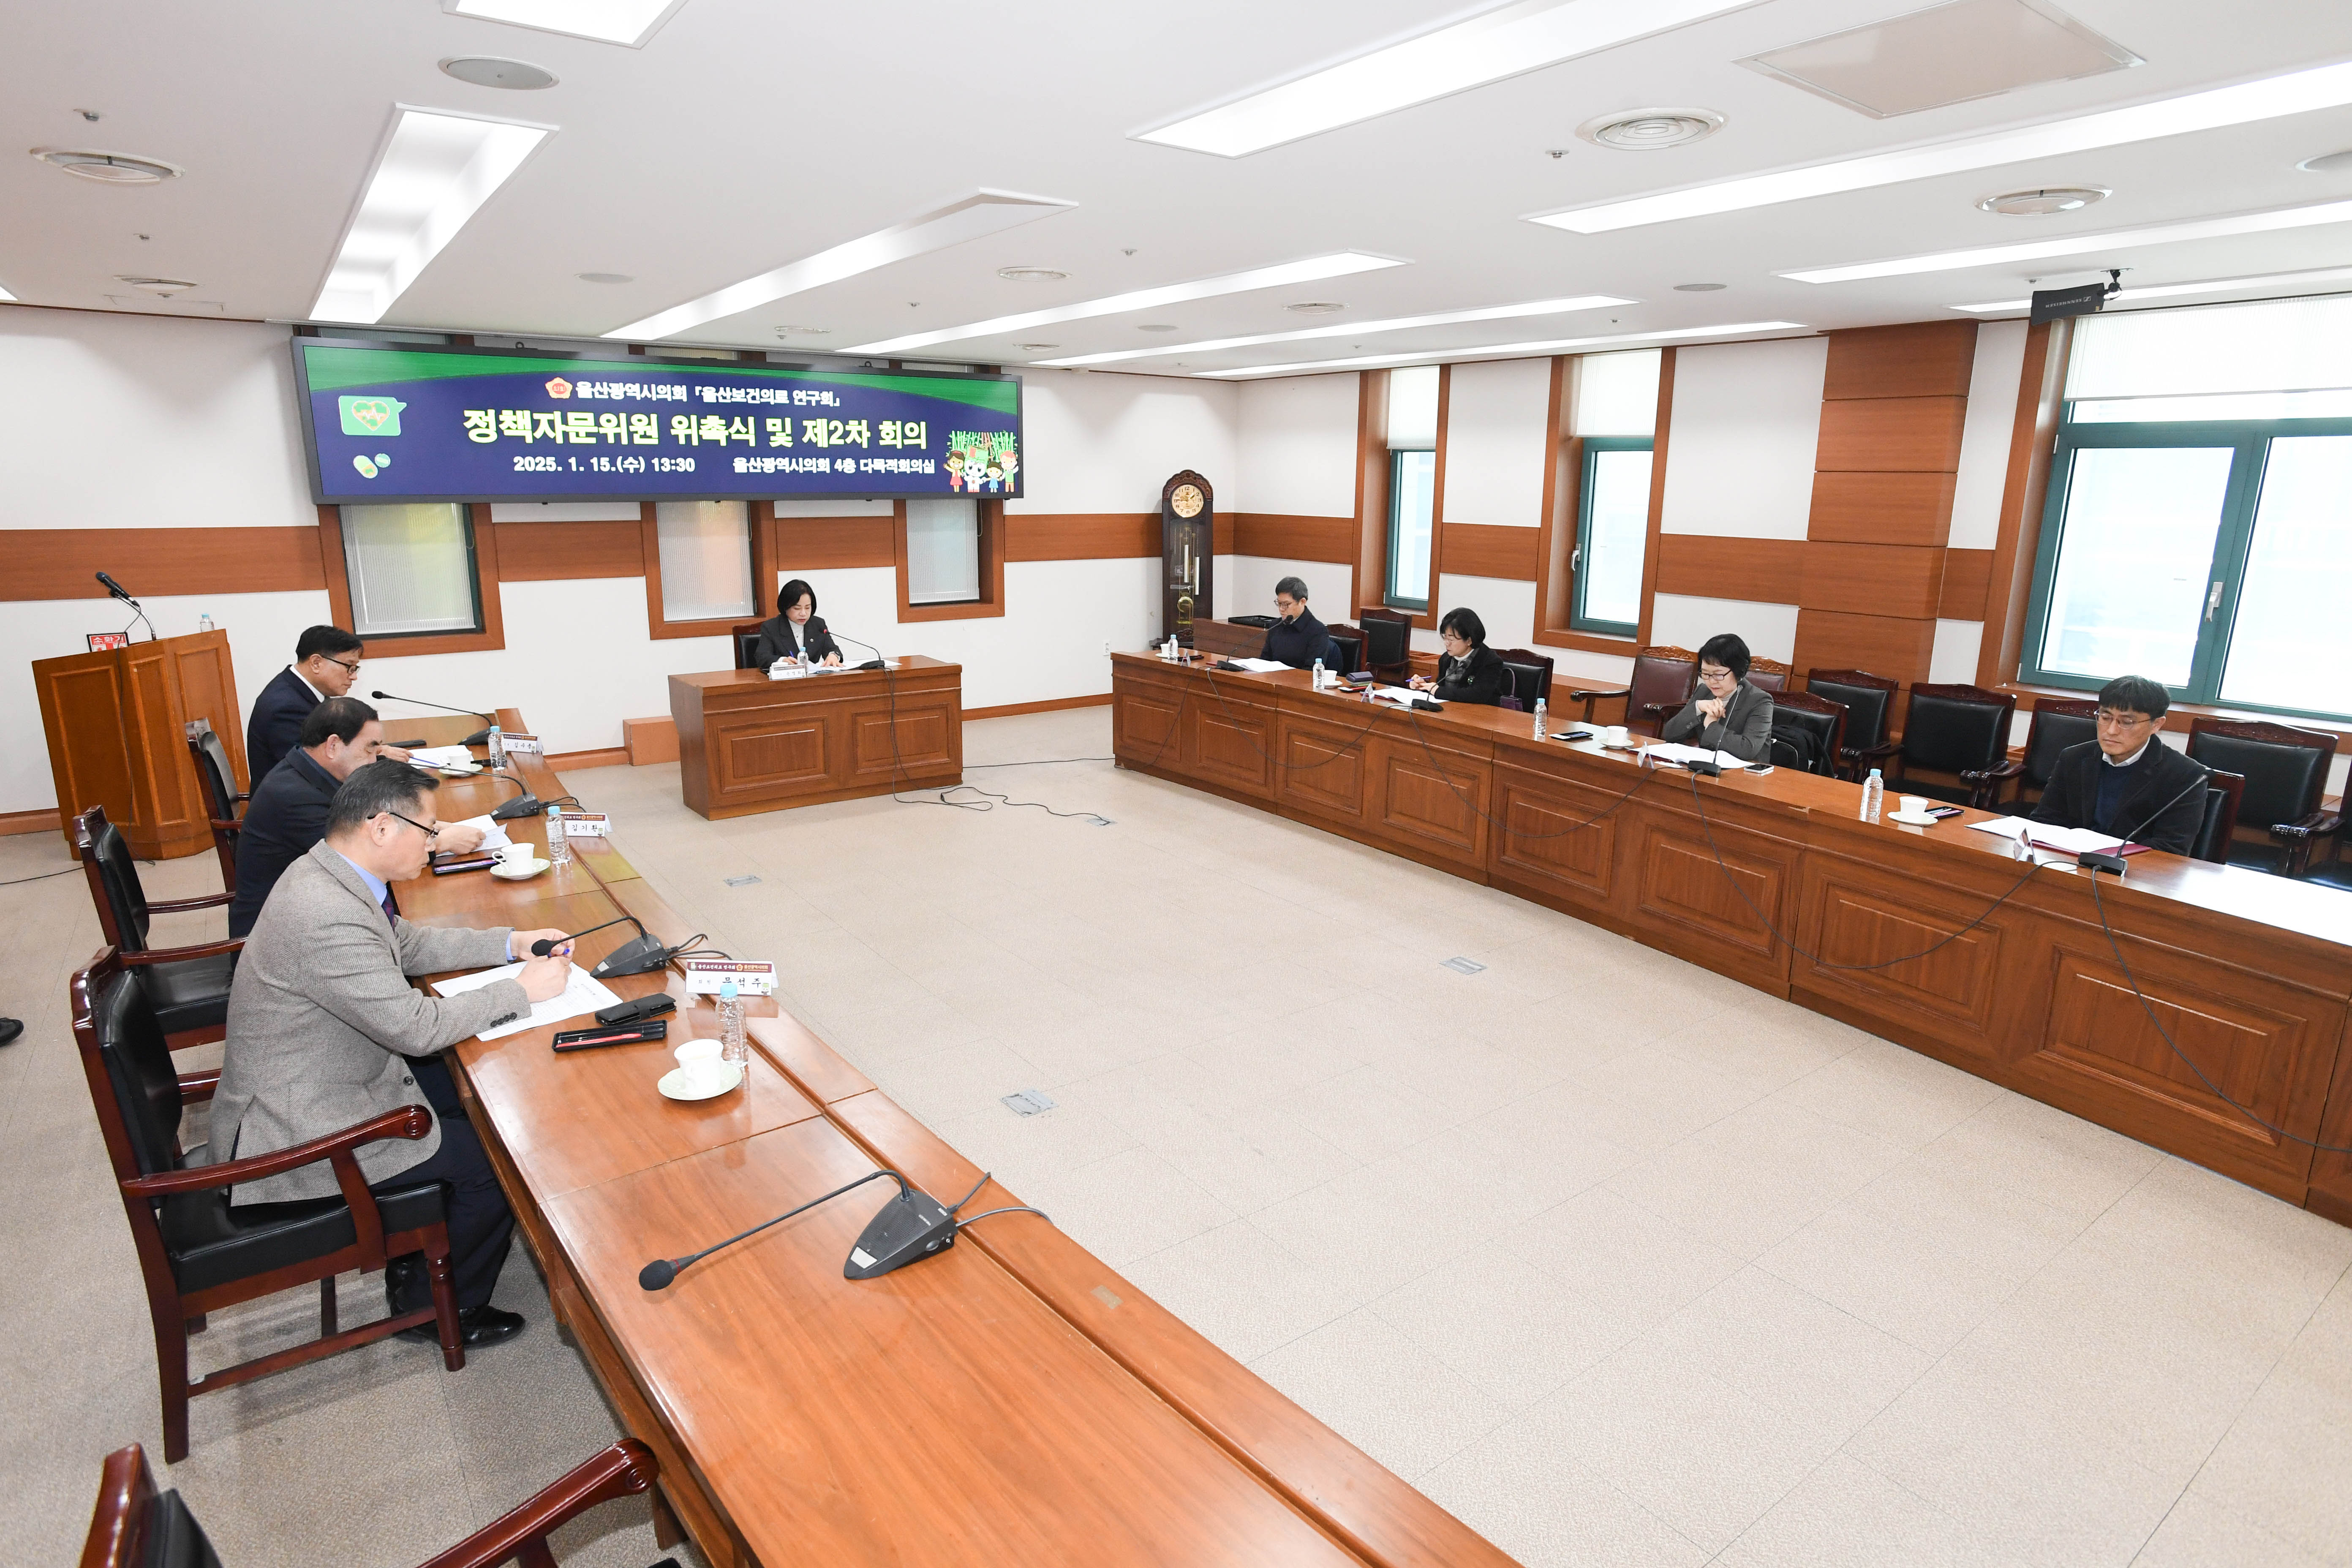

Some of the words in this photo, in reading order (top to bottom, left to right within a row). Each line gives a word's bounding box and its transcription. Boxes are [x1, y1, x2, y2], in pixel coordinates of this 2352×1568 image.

[2045, 298, 2082, 308] SENNHEISER
[575, 381, 688, 402] 울산광역시의회
[463, 408, 659, 445] 정책자문위원
[670, 414, 756, 447] 위촉식
[765, 417, 794, 448] 및
[801, 418, 871, 449] 제2차
[878, 420, 927, 450] 회의
[513, 455, 563, 472] 2025.
[568, 456, 584, 472] 1.
[590, 455, 645, 474] 15.(수)
[651, 457, 696, 472] 13:30
[732, 457, 830, 474] 울산광역시의회
[833, 457, 857, 474] 4층
[859, 457, 935, 474] 다목적회의실
